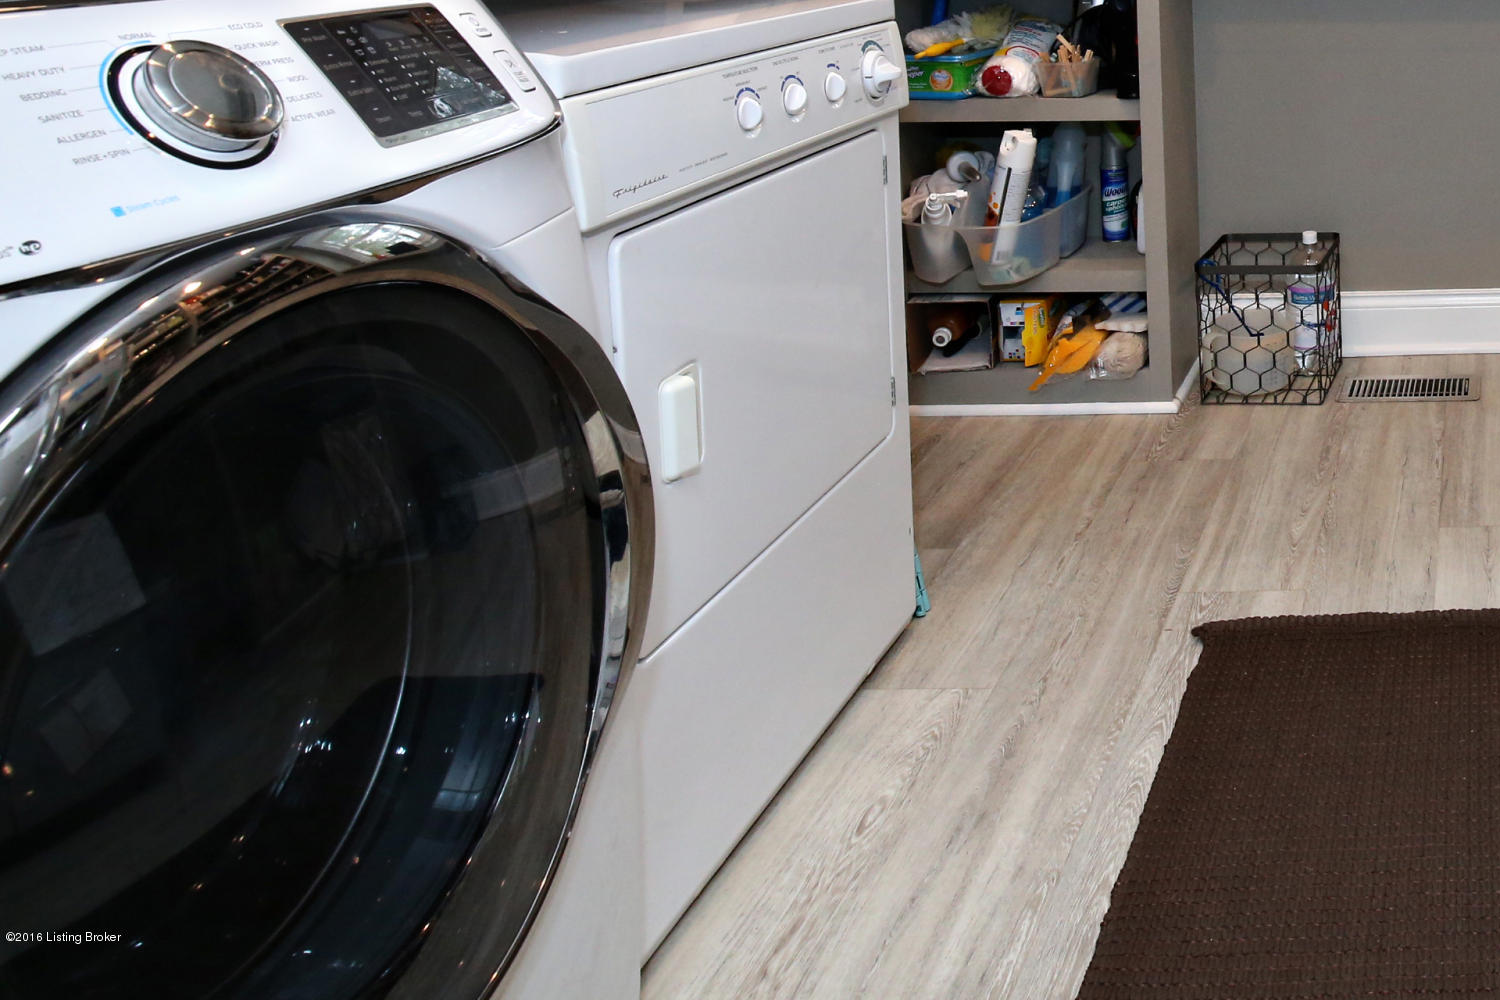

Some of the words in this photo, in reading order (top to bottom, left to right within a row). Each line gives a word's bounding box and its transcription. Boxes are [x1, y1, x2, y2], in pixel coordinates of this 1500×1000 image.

[118, 31, 156, 41] NORMAL
[10, 44, 46, 56] STEAM
[1, 67, 36, 81] HEAVY
[38, 66, 66, 77] DUTY
[19, 88, 68, 102] BEDDING
[37, 109, 85, 124] SANITIZE
[56, 129, 107, 145] ALLERGEN
[612, 174, 669, 199] Frigidaire
